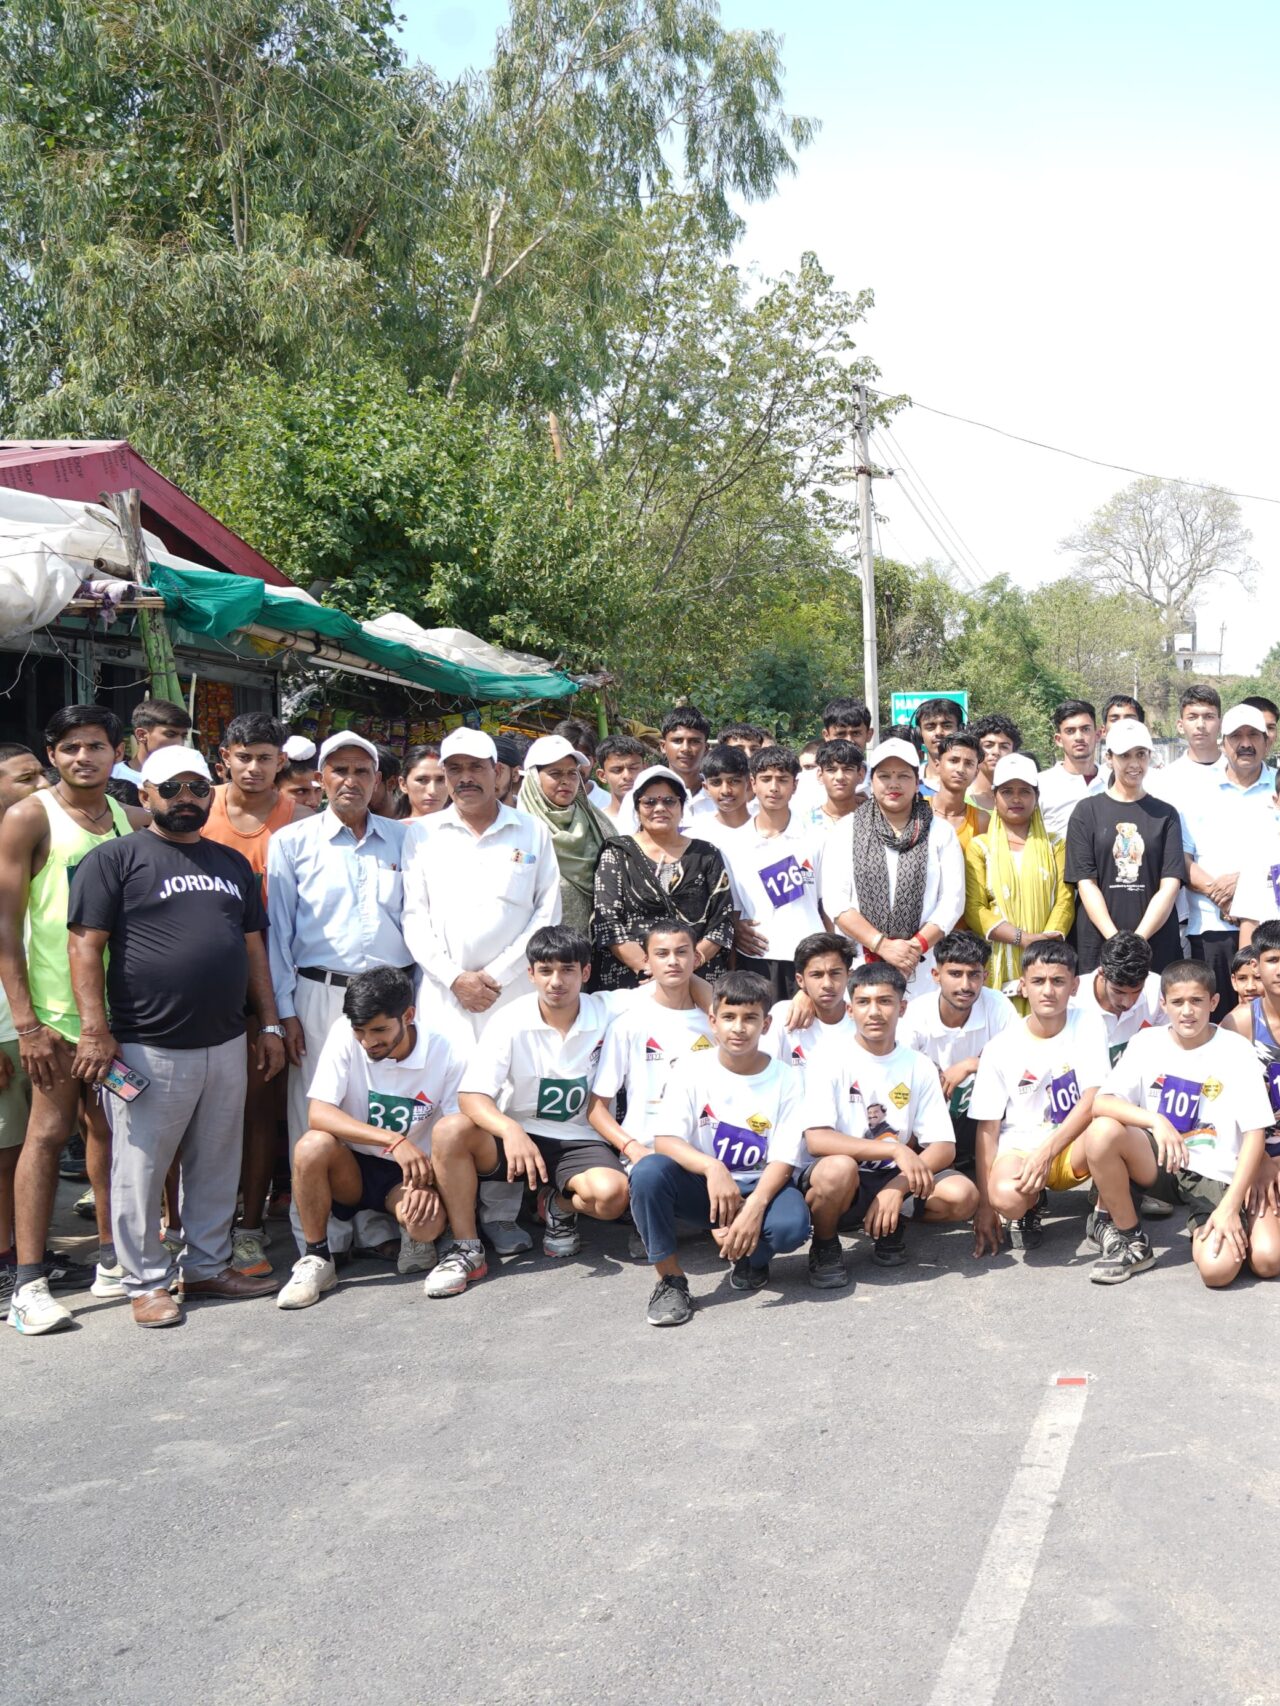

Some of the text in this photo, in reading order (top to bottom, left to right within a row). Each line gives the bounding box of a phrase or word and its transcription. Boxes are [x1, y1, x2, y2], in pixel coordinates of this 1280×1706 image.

[160, 874, 242, 901] JORDAN
[767, 865, 803, 897] 126
[541, 1086, 586, 1114] 20
[1050, 1082, 1080, 1113] 108
[1164, 1089, 1200, 1119] 107
[369, 1102, 410, 1134] 33
[717, 1137, 761, 1167] 110
